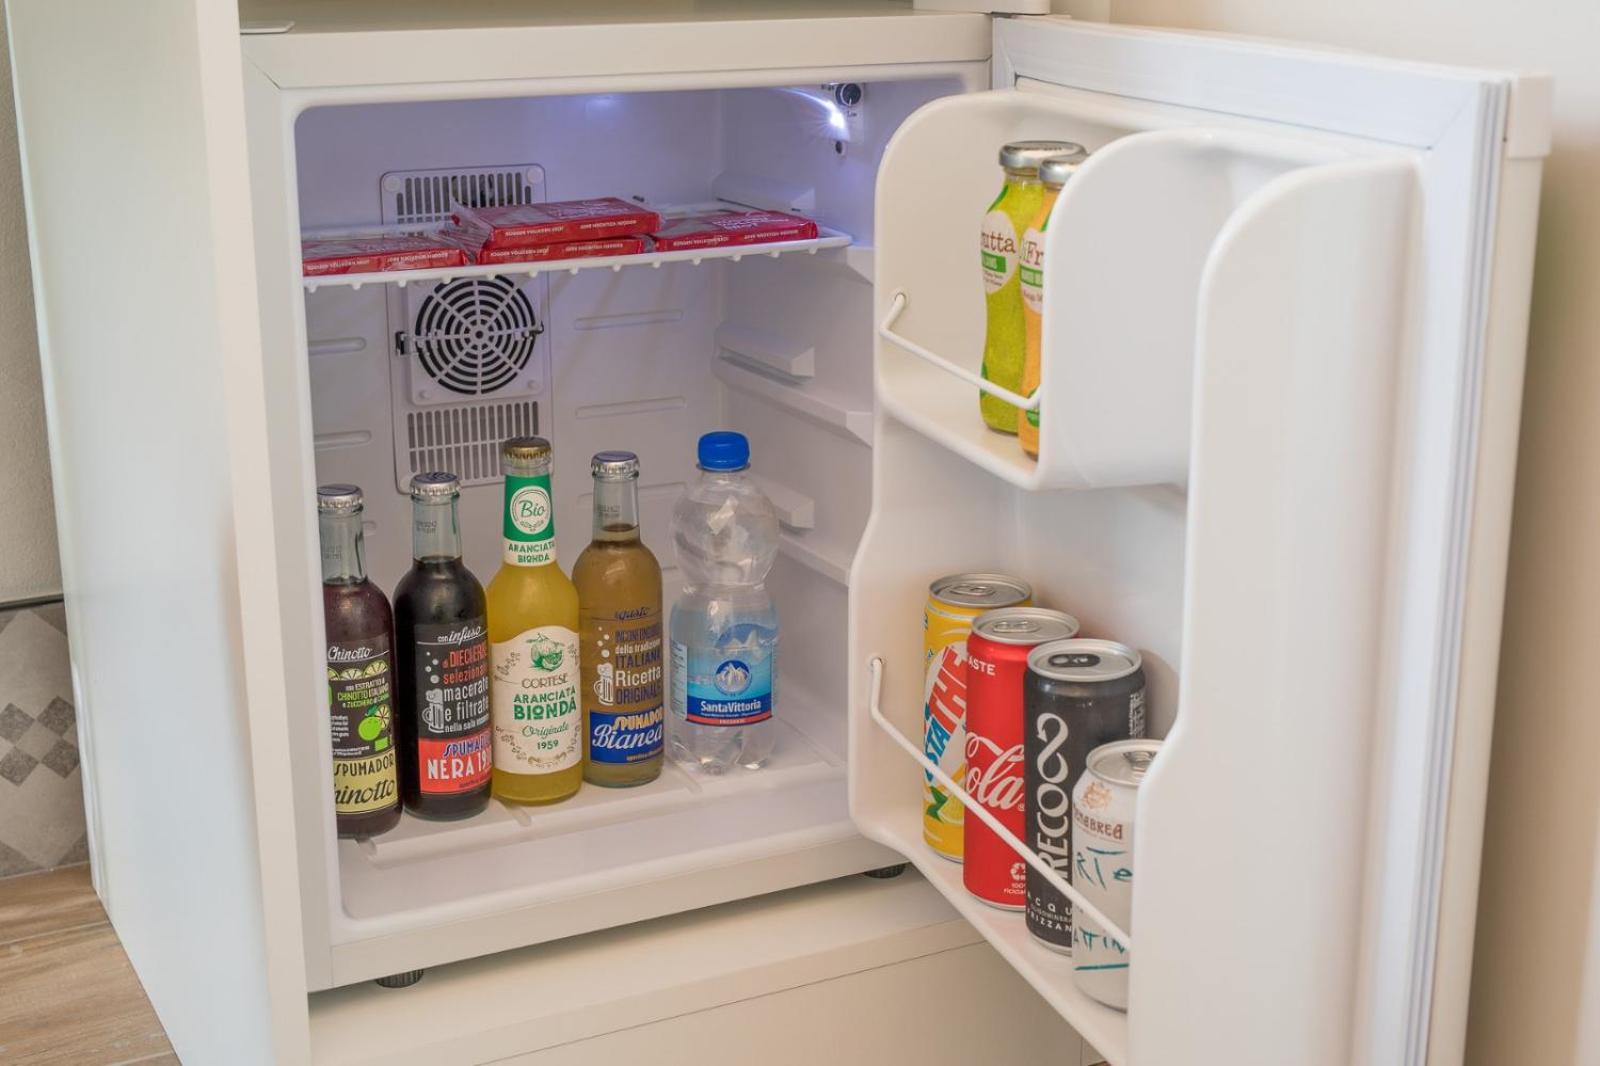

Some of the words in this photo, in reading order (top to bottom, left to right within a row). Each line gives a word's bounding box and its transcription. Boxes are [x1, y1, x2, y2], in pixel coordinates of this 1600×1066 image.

[518, 499, 546, 518] Bio
[517, 553, 550, 563] BIONDA
[449, 626, 481, 645] infuso
[327, 645, 371, 661] Chinotto
[968, 656, 996, 677] ASTE
[521, 672, 569, 689] CORTESE
[615, 666, 661, 687] Ricetta
[338, 690, 369, 701] CHINOTTO
[513, 685, 576, 704] ARANCIATA
[445, 708, 451, 722] e
[513, 696, 577, 721] BIONDA
[521, 721, 569, 740] Originale
[592, 723, 663, 750] Bianca
[537, 739, 559, 750] 1959
[427, 754, 475, 780] NERA
